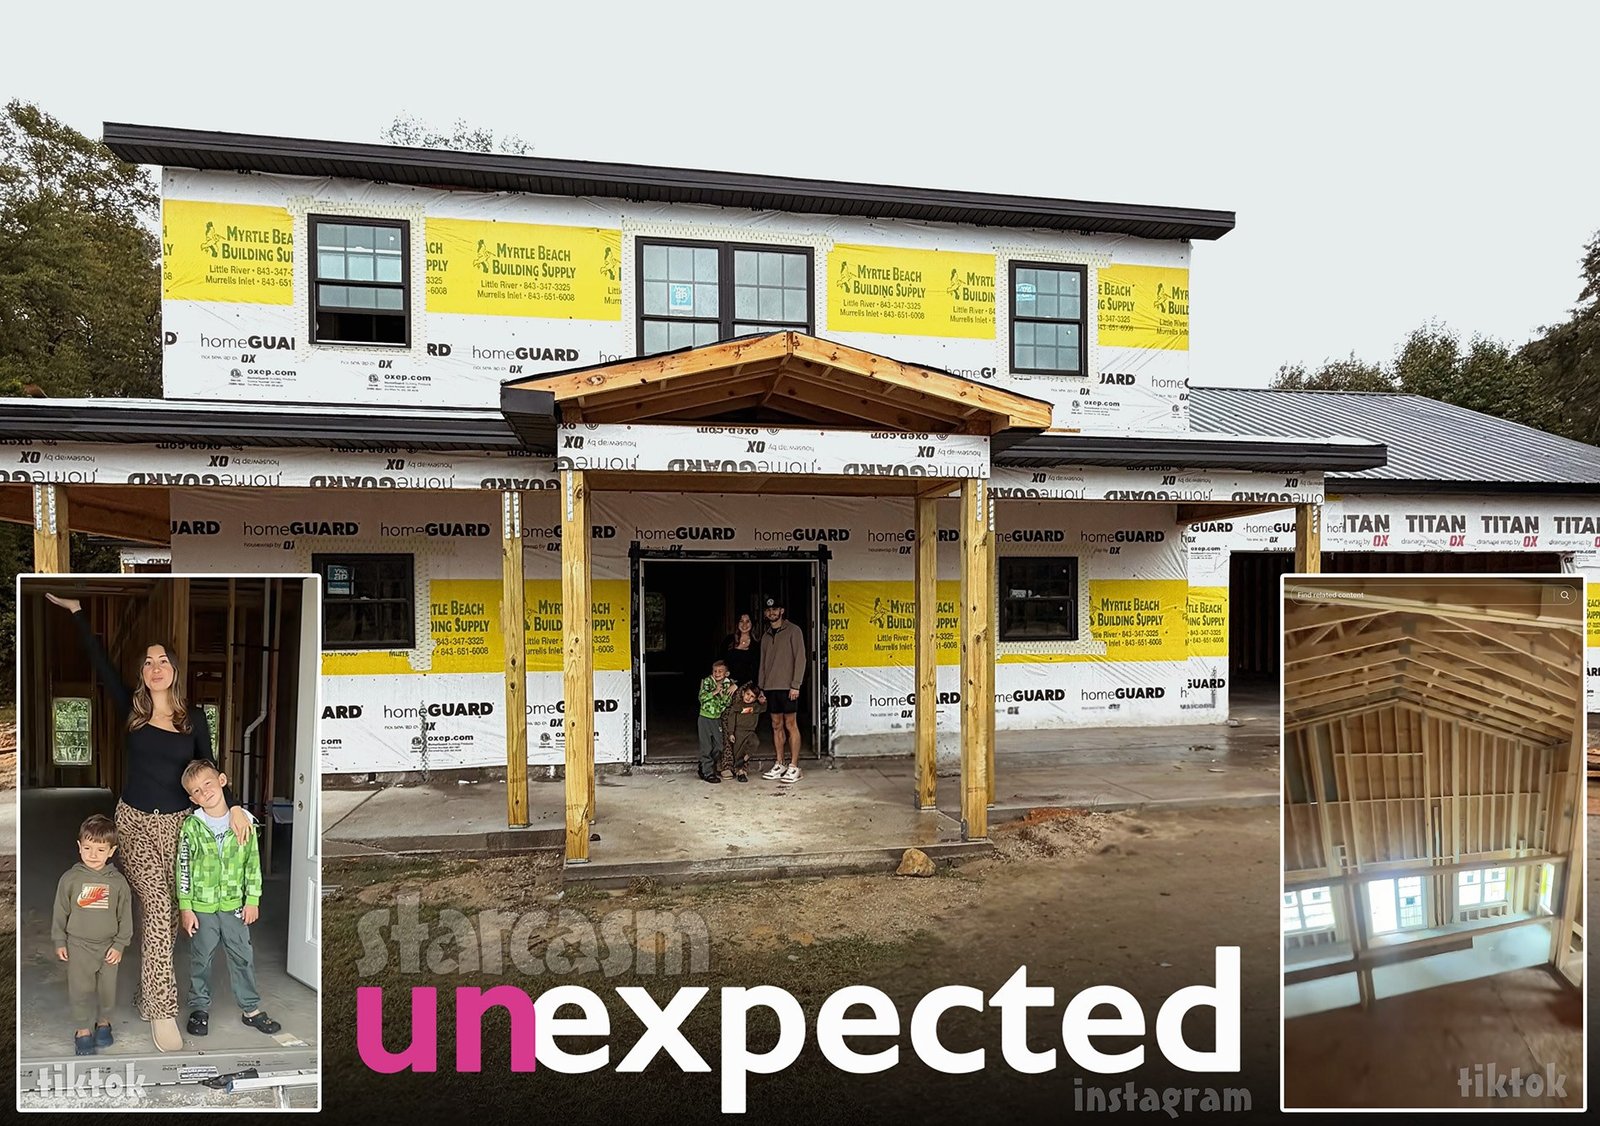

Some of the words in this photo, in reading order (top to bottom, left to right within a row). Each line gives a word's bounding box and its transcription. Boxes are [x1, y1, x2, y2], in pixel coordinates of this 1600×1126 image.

[227, 226, 269, 243] MYRTLE
[222, 244, 274, 261] BUILDING
[496, 243, 535, 259] MYRTLE
[538, 246, 570, 261] BEACH
[210, 265, 230, 274] Little
[231, 266, 250, 274] River
[493, 261, 539, 276] BUILDING
[542, 264, 576, 278] SUPPLY
[857, 265, 891, 279] MYRTLE
[893, 268, 921, 282] BEACH
[206, 276, 237, 284] Murrells
[239, 277, 255, 285] Inlet
[481, 279, 498, 289] Little
[500, 281, 517, 290] River
[524, 282, 570, 291] 843-347-3325
[854, 280, 894, 297] BUILDING
[897, 283, 925, 298] SUPPLY
[1105, 283, 1131, 296] BEACH
[477, 291, 505, 299] Murrells
[528, 292, 575, 301] 843-651-6008
[843, 299, 859, 308] Little
[861, 300, 877, 309] River
[880, 300, 921, 309] 843-347-3325
[953, 305, 968, 314] Little
[970, 306, 984, 314] River
[1108, 300, 1135, 312] SUPPLY
[840, 308, 863, 316] Murrells
[865, 309, 879, 317] Inlet
[883, 310, 925, 319] 843-651-6008
[950, 315, 973, 323] Murrells
[241, 354, 256, 363] OX
[473, 345, 579, 361] homeGUARD
[378, 360, 392, 368] OX
[509, 365, 523, 373] OX
[564, 436, 584, 449] OX
[747, 441, 765, 453] OX
[20, 451, 41, 463] OX
[917, 446, 935, 457] OX
[209, 456, 229, 467] OX
[386, 459, 404, 470] OX
[1032, 473, 1046, 483] OX
[1162, 476, 1175, 485] OX
[244, 522, 359, 536] homeGUARD
[381, 523, 490, 536] homeGUARD
[1405, 515, 1466, 533] TITAN
[1481, 516, 1539, 533] TITAN
[636, 527, 735, 540] homeGUARD
[754, 528, 849, 541] homeGUARD
[1081, 531, 1164, 543] homeGUARD
[1373, 535, 1389, 546] OX
[1450, 535, 1465, 546] OX
[1523, 536, 1538, 547] OX
[899, 546, 911, 554] OX
[451, 601, 484, 616] BEACH
[1101, 598, 1132, 611] MYRTLE
[1134, 598, 1159, 611] BEACH
[1200, 602, 1222, 613] BEACH
[1098, 613, 1135, 626] BUILDING
[1137, 613, 1163, 626] SUPPLY
[1202, 615, 1225, 626] SUPPLY
[455, 618, 489, 633] SUPPLY
[1122, 629, 1158, 637] 843-347-3325
[437, 637, 484, 646] 843-347-3325
[1125, 638, 1162, 646] 843-651-6008
[440, 648, 488, 656] 843-651-6008
[1082, 688, 1165, 700] homeGUARD
[384, 703, 493, 718] homeGUARD
[901, 710, 912, 718] OX
